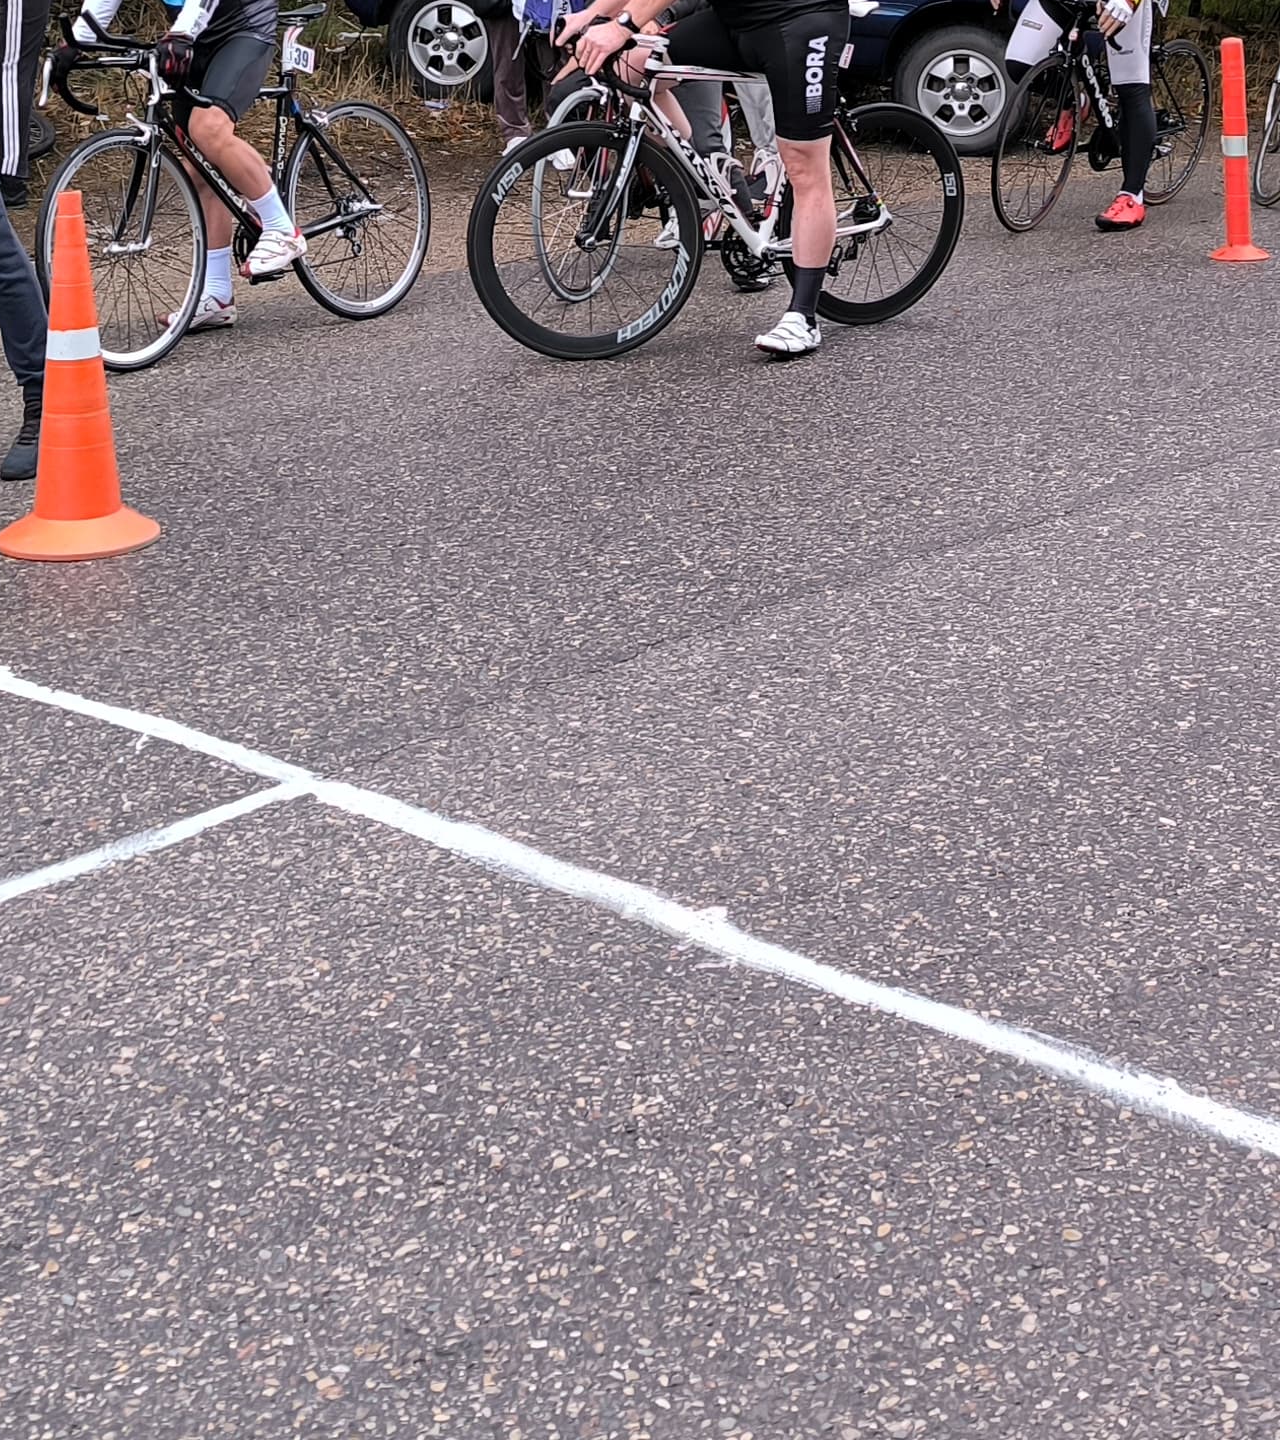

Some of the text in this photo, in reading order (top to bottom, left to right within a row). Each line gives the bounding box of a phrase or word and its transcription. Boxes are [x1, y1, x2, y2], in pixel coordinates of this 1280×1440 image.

[294, 47, 310, 69] 39
[805, 35, 829, 98] BORA
[616, 247, 691, 344] MICROTECH
